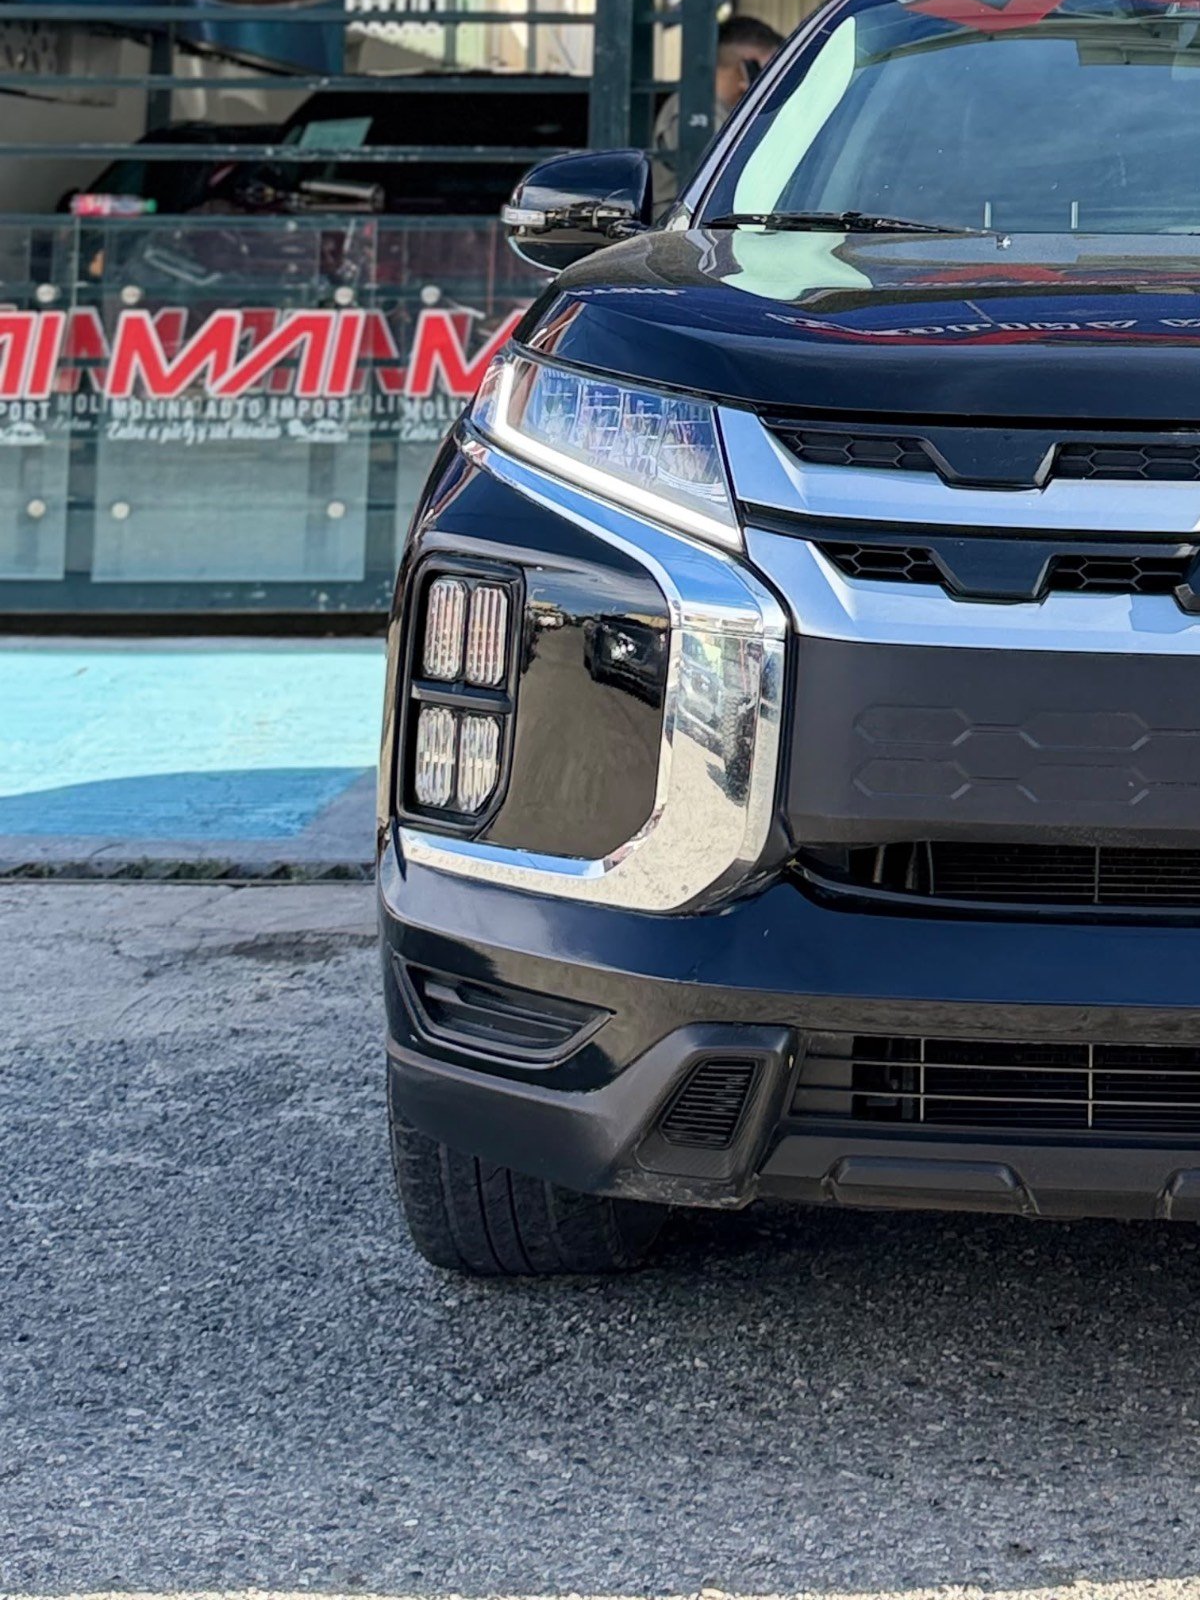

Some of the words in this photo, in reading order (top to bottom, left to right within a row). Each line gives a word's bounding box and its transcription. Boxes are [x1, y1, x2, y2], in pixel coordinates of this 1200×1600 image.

[105, 308, 366, 400] MAI
[111, 398, 196, 420] MOLINA
[205, 398, 261, 419] AUTO
[268, 397, 353, 420] IMPORT
